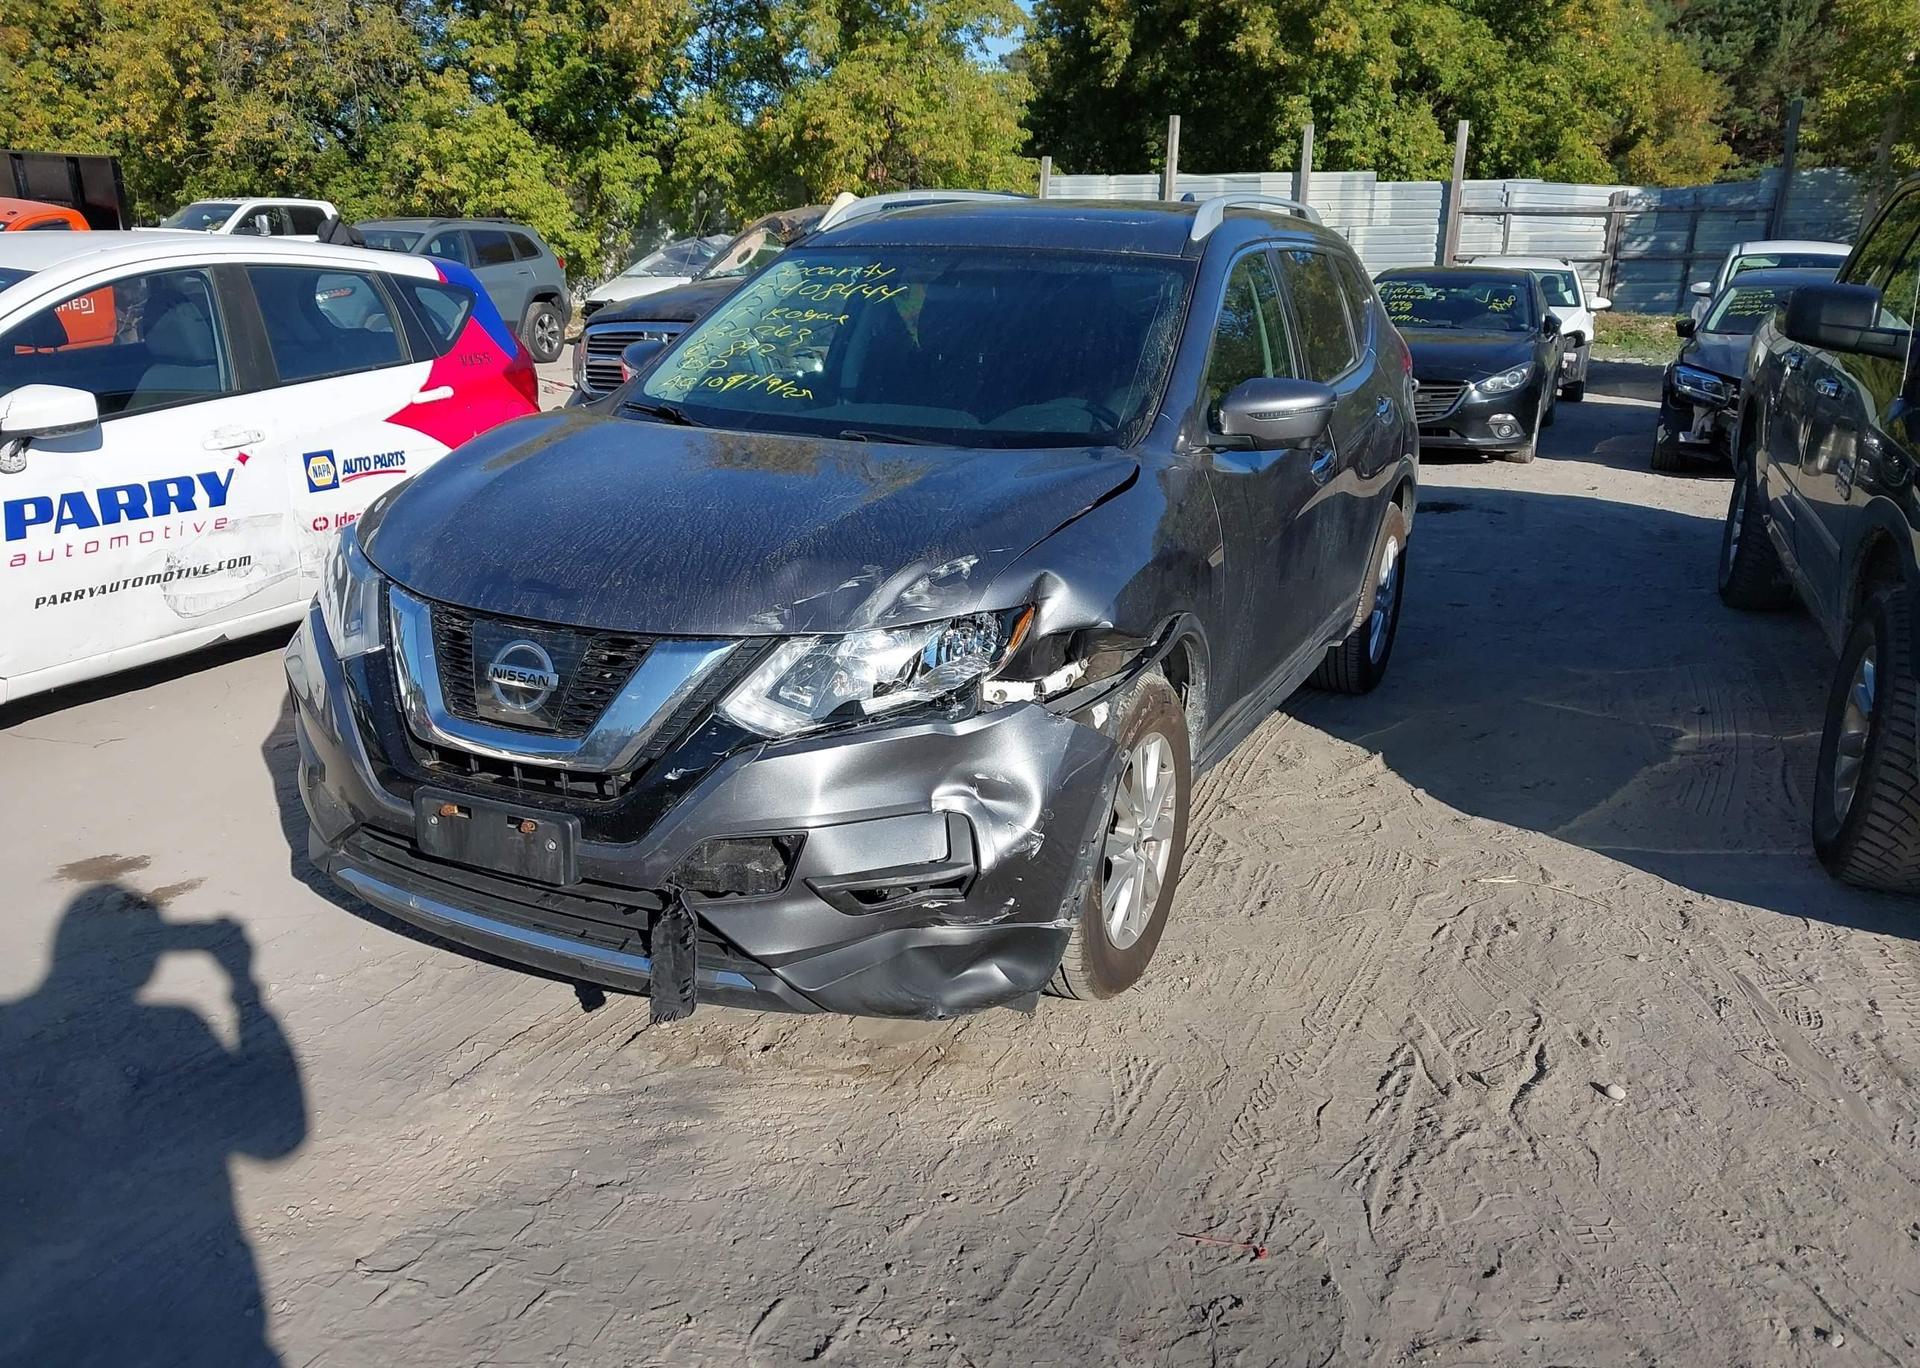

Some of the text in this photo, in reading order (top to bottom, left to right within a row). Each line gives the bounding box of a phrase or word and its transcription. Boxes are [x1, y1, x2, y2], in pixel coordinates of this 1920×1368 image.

[312, 463, 331, 478] NAPA
[342, 450, 406, 475] AUTO PARTS
[4, 468, 235, 542] PARRY
[9, 517, 228, 568] automotive
[492, 667, 550, 687] NISSAN
